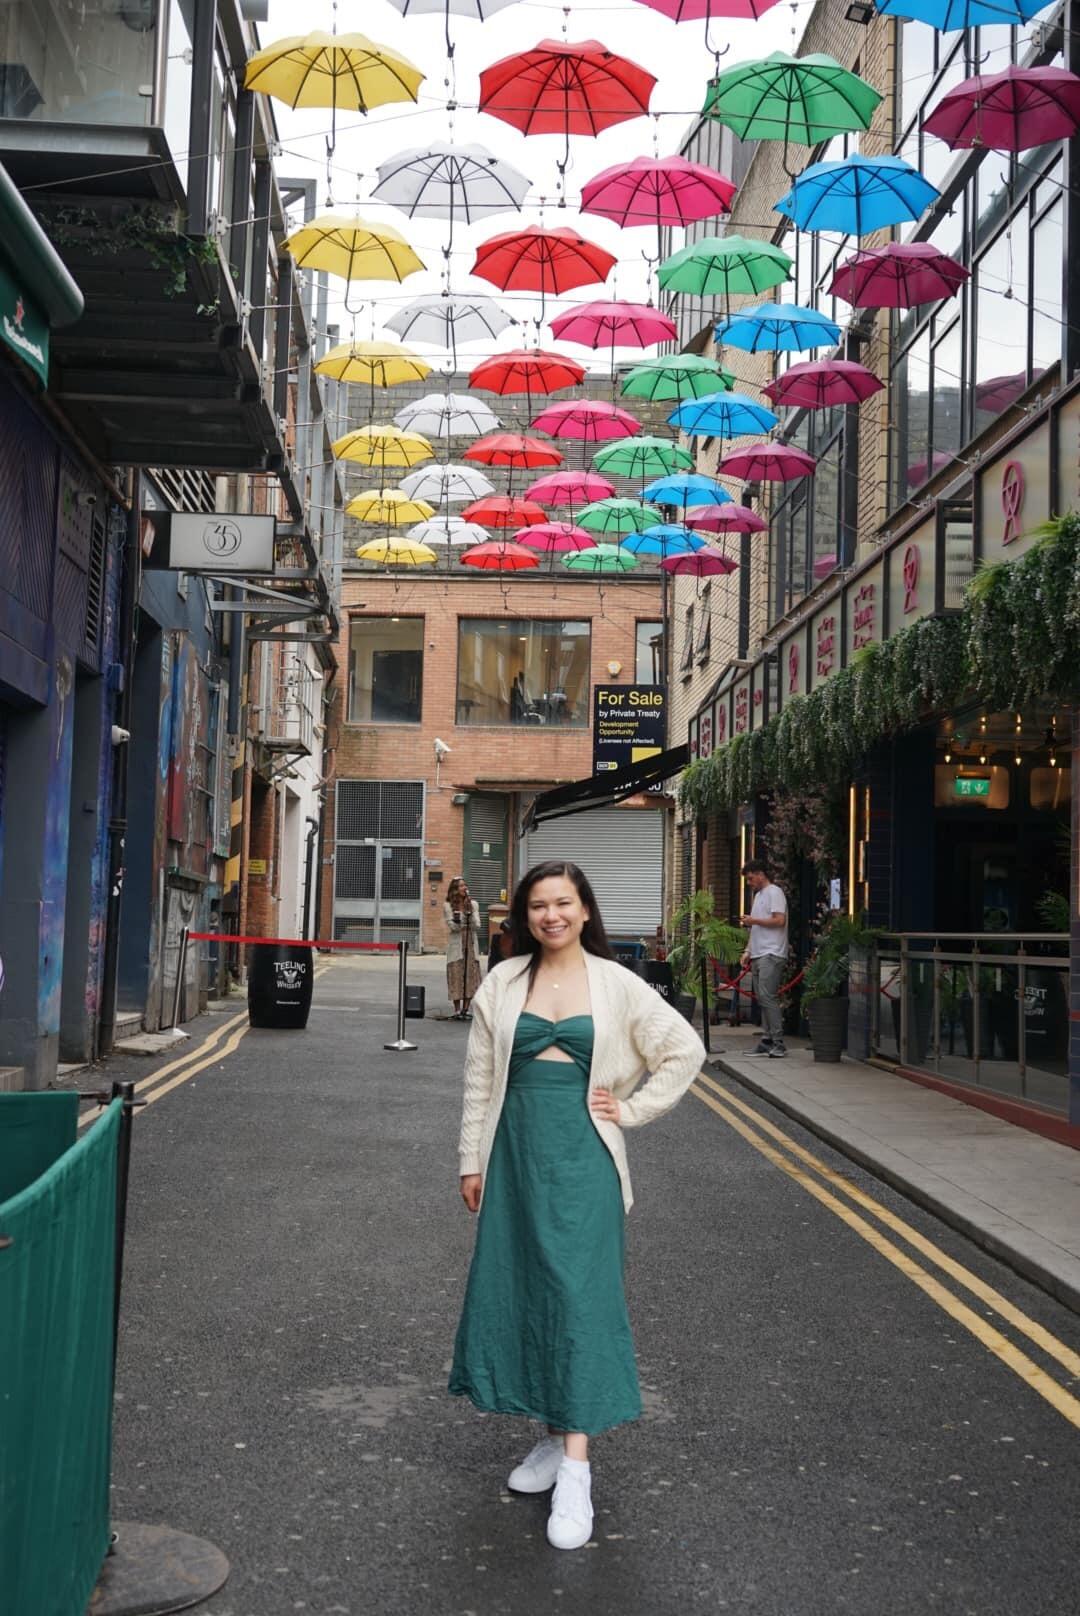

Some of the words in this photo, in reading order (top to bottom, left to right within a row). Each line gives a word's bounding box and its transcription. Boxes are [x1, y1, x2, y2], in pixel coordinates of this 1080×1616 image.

[598, 691, 624, 705] For
[629, 691, 662, 705] Sale
[638, 710, 660, 718] Treaty
[273, 961, 306, 973] TEELING
